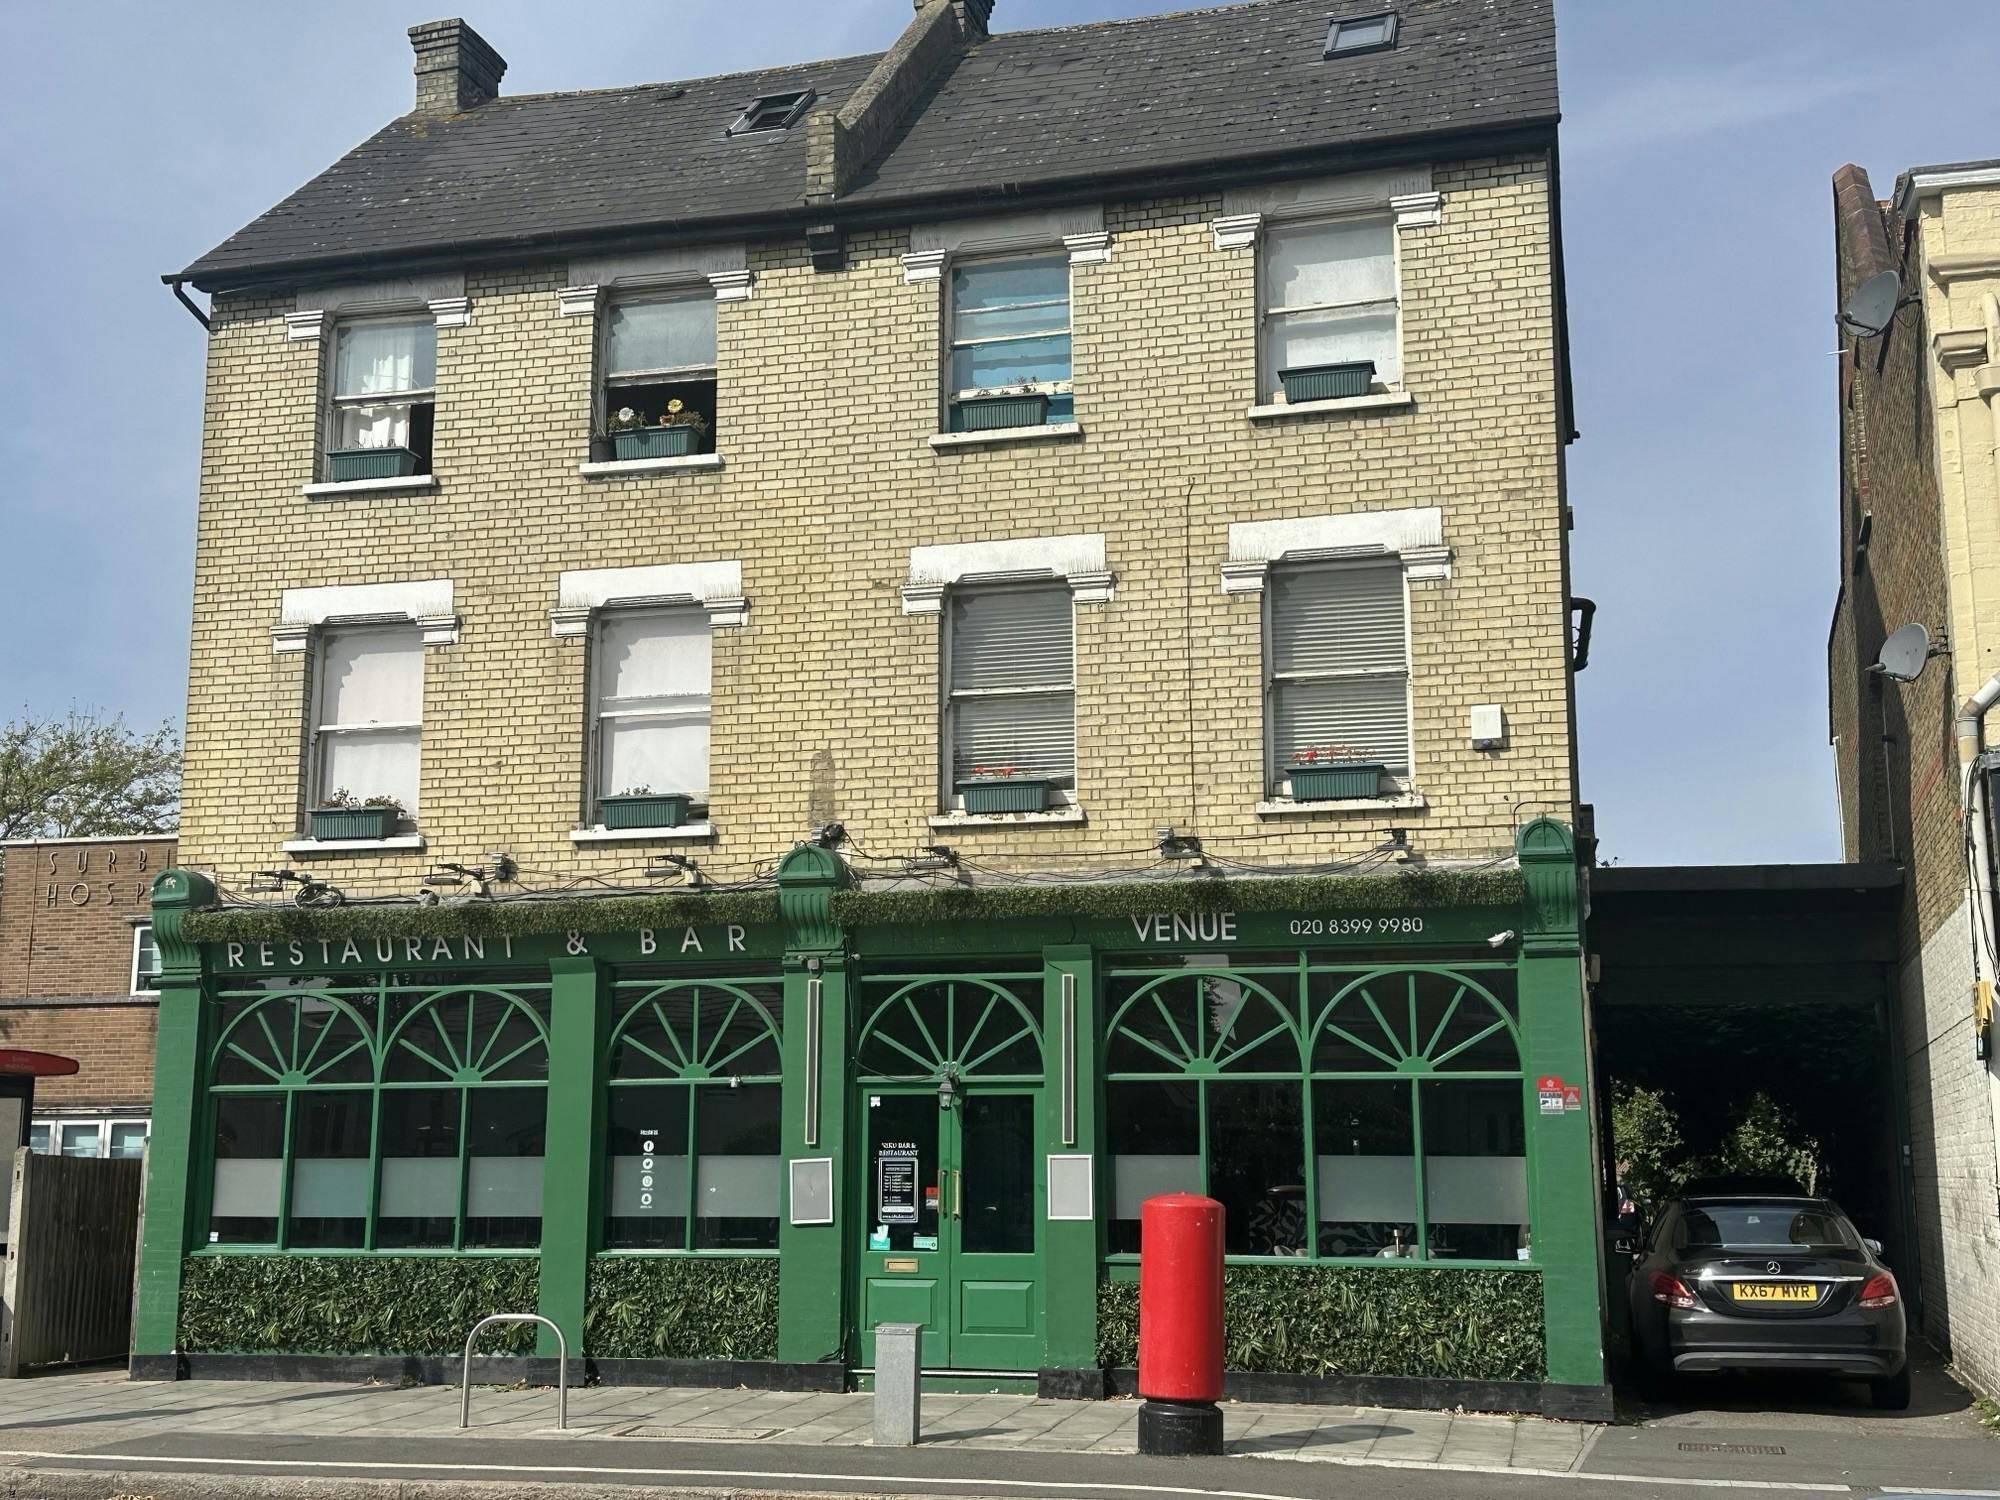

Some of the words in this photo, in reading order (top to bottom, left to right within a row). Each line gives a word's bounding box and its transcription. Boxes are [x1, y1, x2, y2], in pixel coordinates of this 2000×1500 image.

[1130, 912, 1237, 942] VENUE
[1290, 919, 1323, 935] 020
[1329, 918, 1373, 934] 8399
[1378, 917, 1424, 933] 9980
[227, 933, 512, 968] RESTAURANT
[566, 928, 588, 955] &
[640, 925, 747, 955] BAR
[878, 1149, 919, 1157] RESTAURANT
[1739, 1284, 1777, 1298] KX67
[1781, 1284, 1810, 1298] MVR
